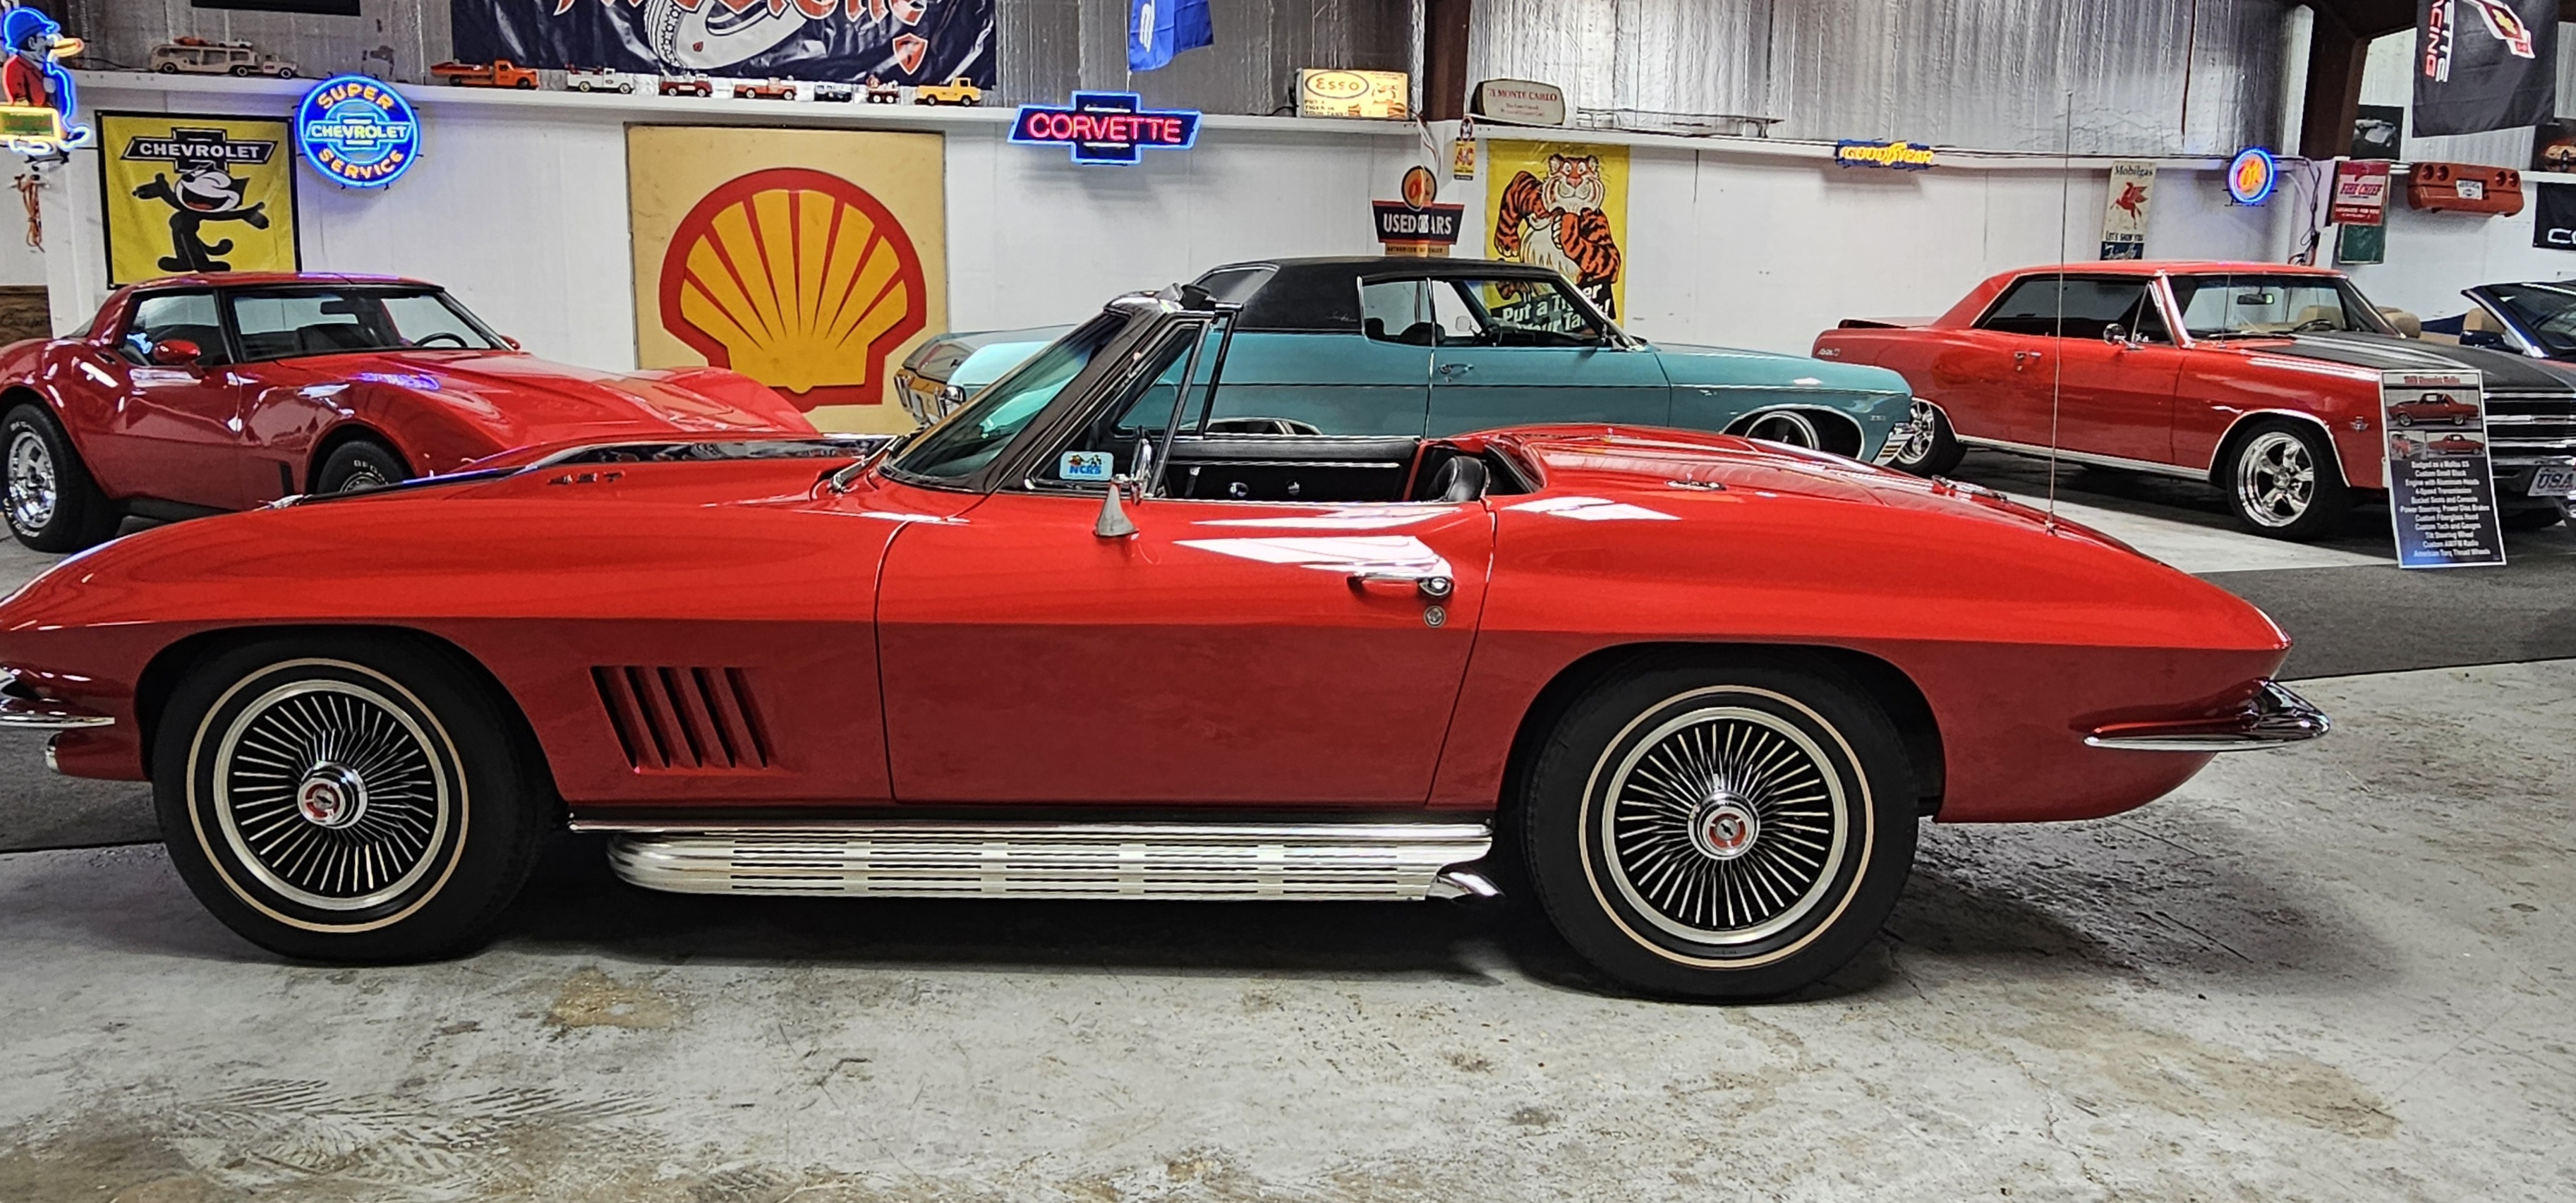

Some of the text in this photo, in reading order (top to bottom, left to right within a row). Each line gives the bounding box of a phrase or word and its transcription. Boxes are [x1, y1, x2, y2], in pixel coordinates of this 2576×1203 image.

[318, 83, 394, 110] SUPER
[1497, 90, 1525, 99] MONTE
[1529, 92, 1557, 102] CARLO
[311, 124, 407, 140] CHEVROLET
[1027, 112, 1183, 143] CORVETTE
[140, 143, 261, 159] CHEVROLET
[318, 148, 404, 180] SERVICE
[2114, 165, 2153, 179] Mobilgas
[1383, 213, 1452, 235] USED ARS
[1502, 301, 1532, 322] Put
[1536, 301, 1548, 316] a
[1069, 464, 1102, 475] NCRS
[2536, 473, 2574, 490] USA
